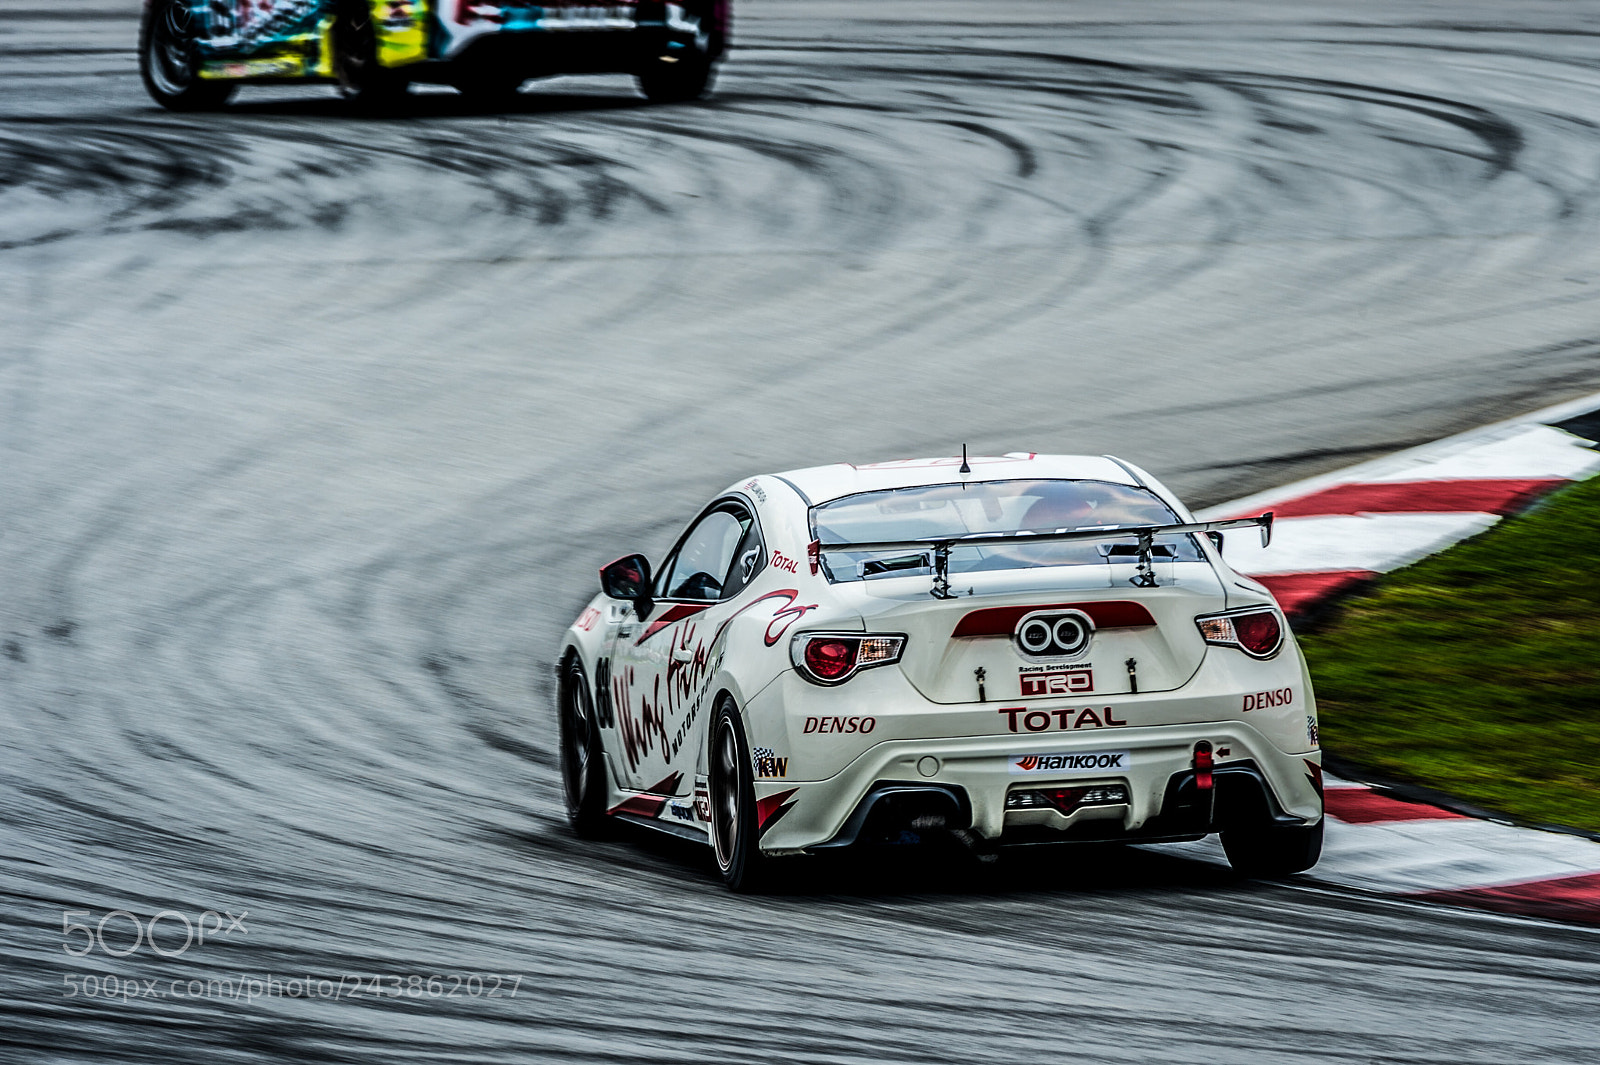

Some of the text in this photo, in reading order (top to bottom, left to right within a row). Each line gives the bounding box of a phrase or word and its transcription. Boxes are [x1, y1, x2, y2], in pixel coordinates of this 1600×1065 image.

[770, 550, 799, 574] TOTAL
[1019, 662, 1092, 673] Racing Development
[1023, 672, 1091, 694] TRD
[1242, 687, 1292, 712] DENSO
[803, 716, 876, 734] DENSO
[998, 706, 1127, 732] TOTAL
[758, 757, 788, 777] KW
